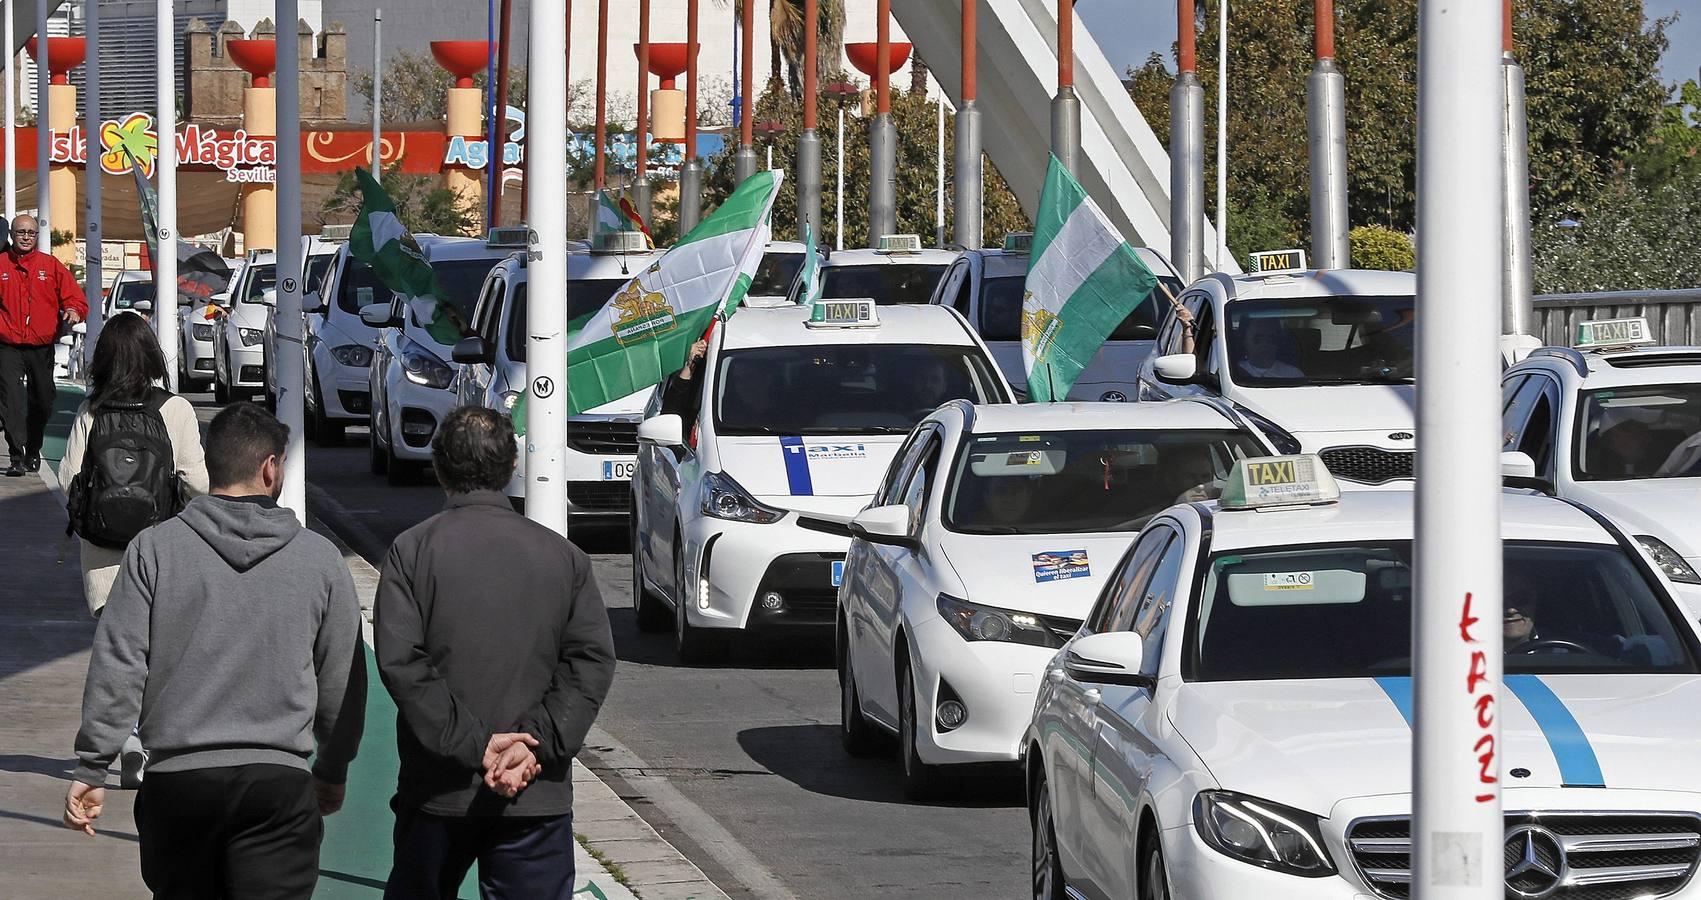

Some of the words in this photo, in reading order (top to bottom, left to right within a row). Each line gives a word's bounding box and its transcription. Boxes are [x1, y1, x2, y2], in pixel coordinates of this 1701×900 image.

[175, 126, 275, 168] Mágica
[446, 136, 520, 168] Aga
[229, 167, 276, 181] Sevilla
[1260, 254, 1290, 270] TAXI
[827, 304, 856, 319] TAXI
[1594, 322, 1628, 340] TAXI
[785, 443, 865, 454] Taxi
[1248, 461, 1295, 485] TAXI
[1270, 484, 1310, 493] TELETAXI
[1059, 566, 1089, 574] liberalizar
